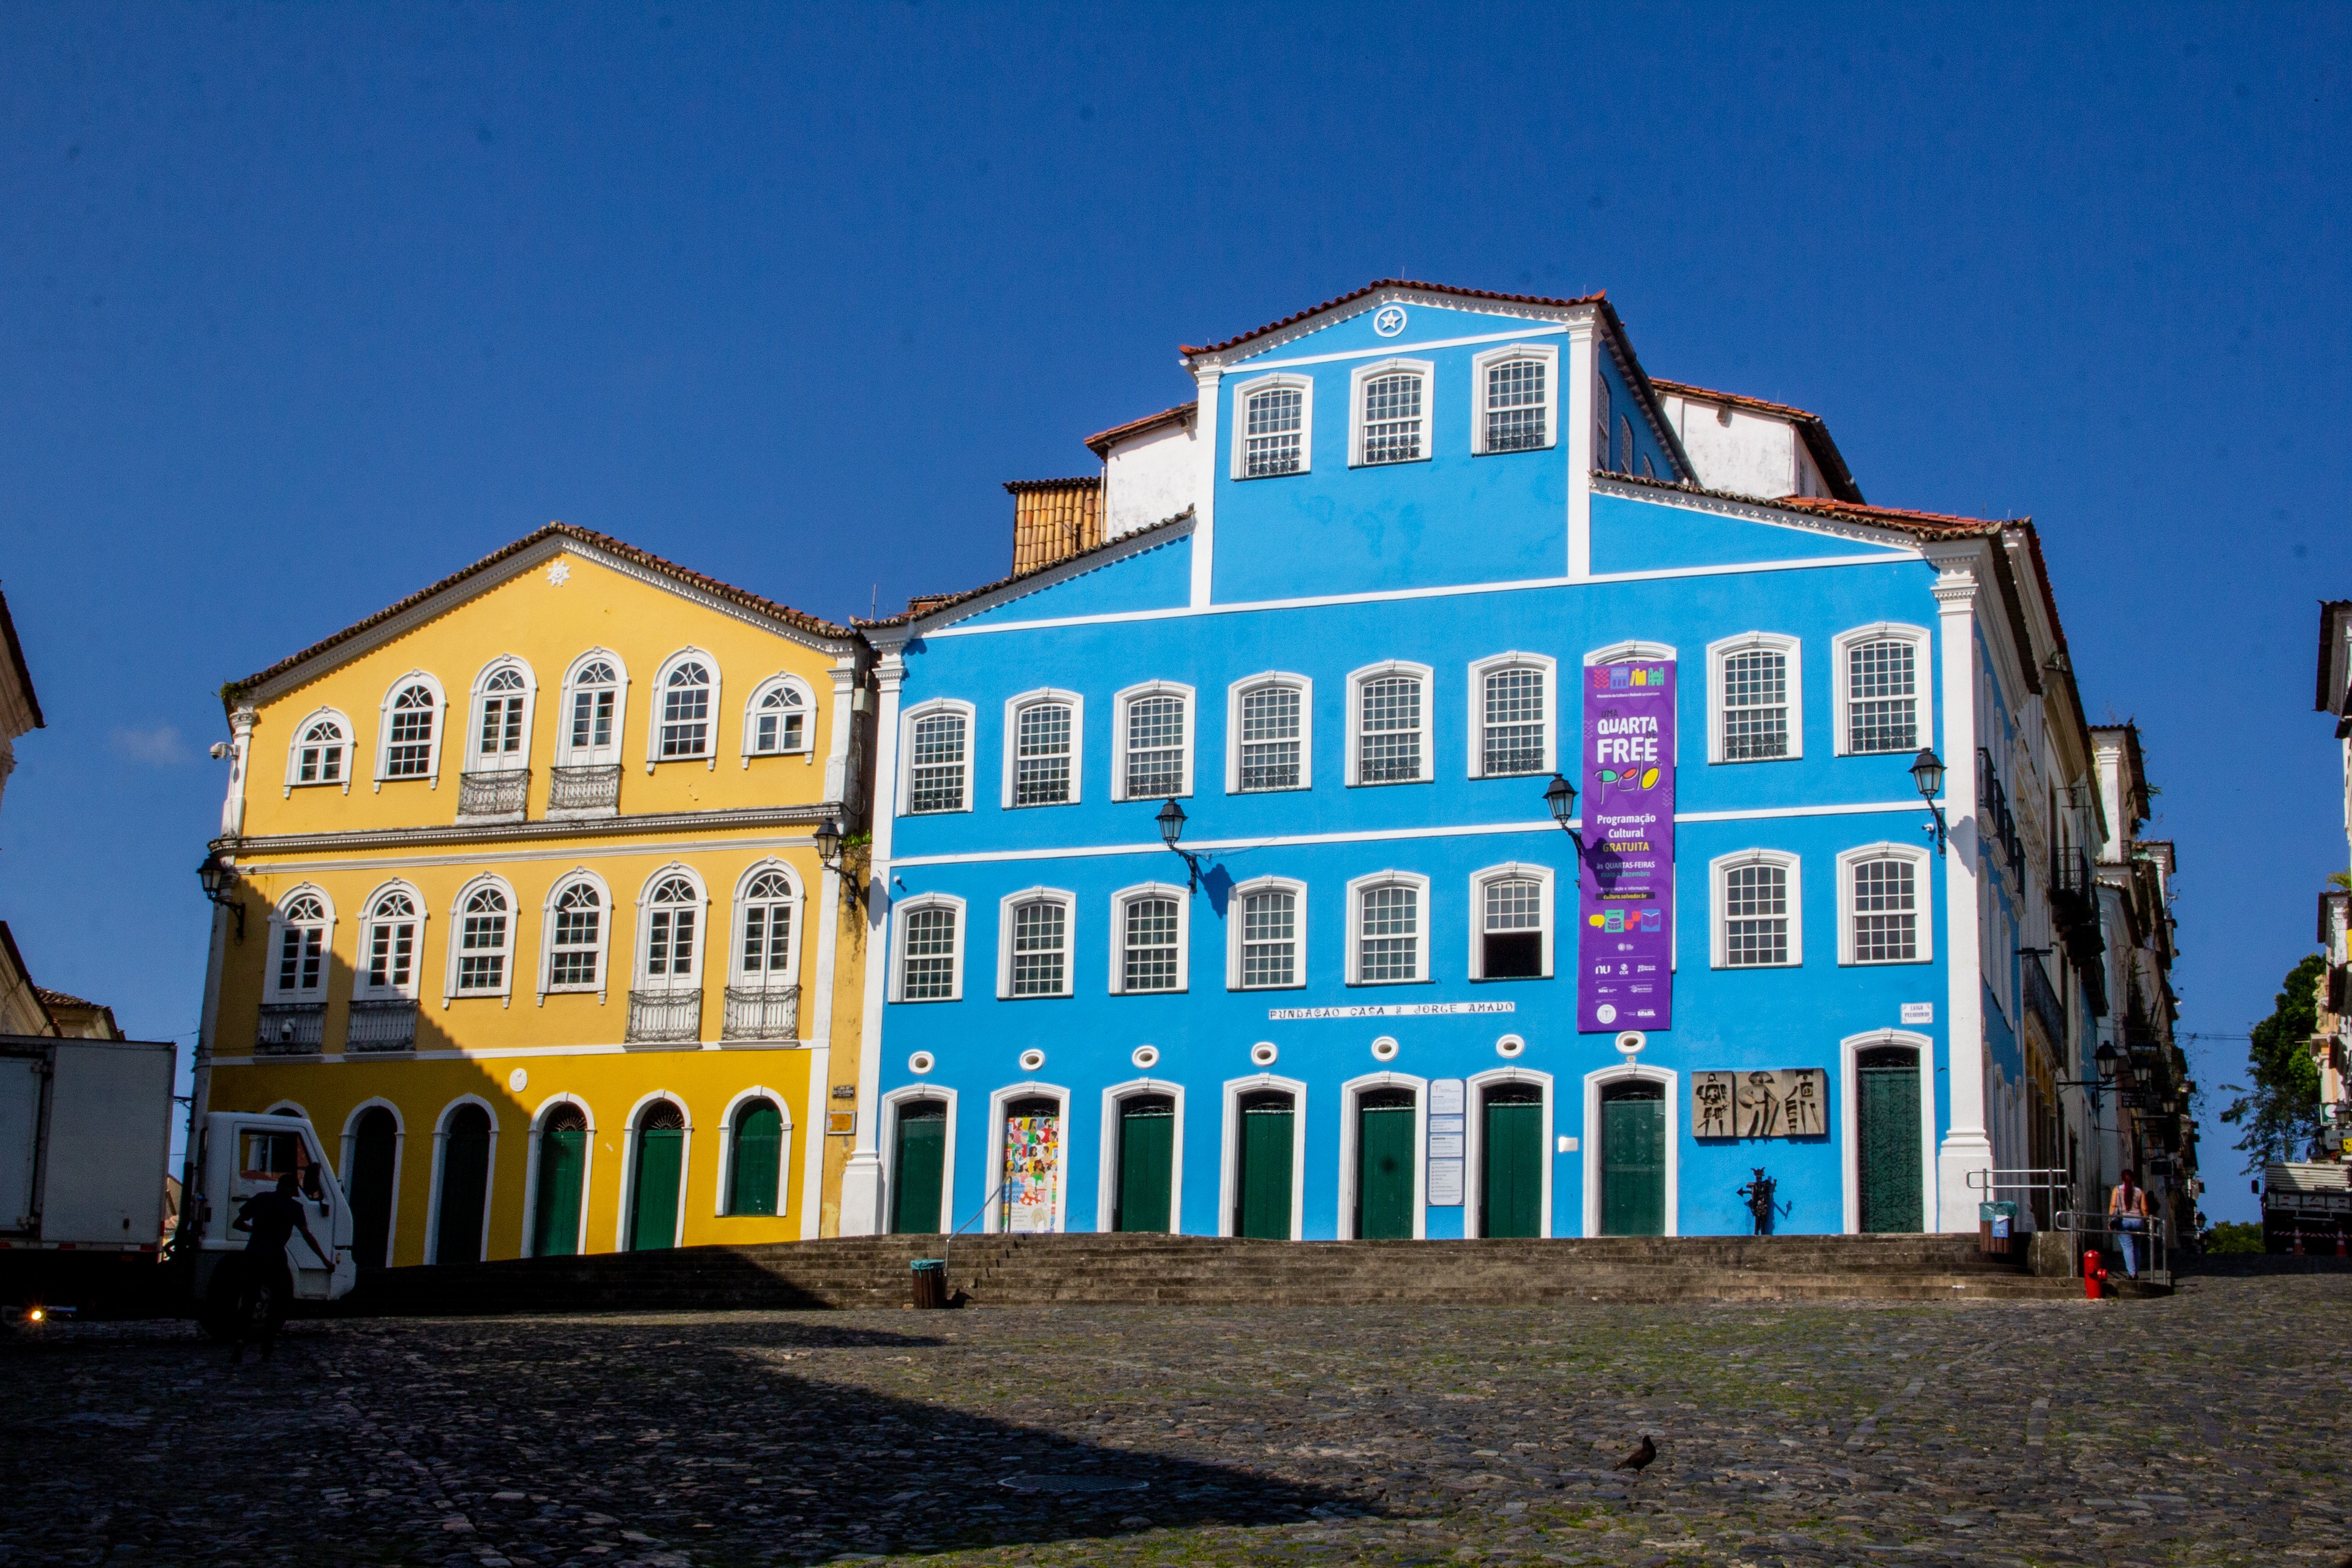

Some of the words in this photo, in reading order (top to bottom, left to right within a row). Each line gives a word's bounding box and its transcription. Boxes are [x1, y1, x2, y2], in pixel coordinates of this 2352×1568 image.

[1601, 709, 1618, 718] UMA
[1597, 717, 1658, 735] QUARTA
[1646, 730, 1657, 739] DE
[1597, 737, 1657, 764] FREE
[1597, 813, 1656, 826] Programação
[1608, 828, 1644, 839] Cultural
[1603, 842, 1649, 852] GRATUITA
[1605, 861, 1655, 870] QUARTAS-FEIRAS
[1350, 1007, 1385, 1016] CASA
[1414, 1004, 1457, 1014] JORGE
[1468, 1002, 1513, 1012] AMADO
